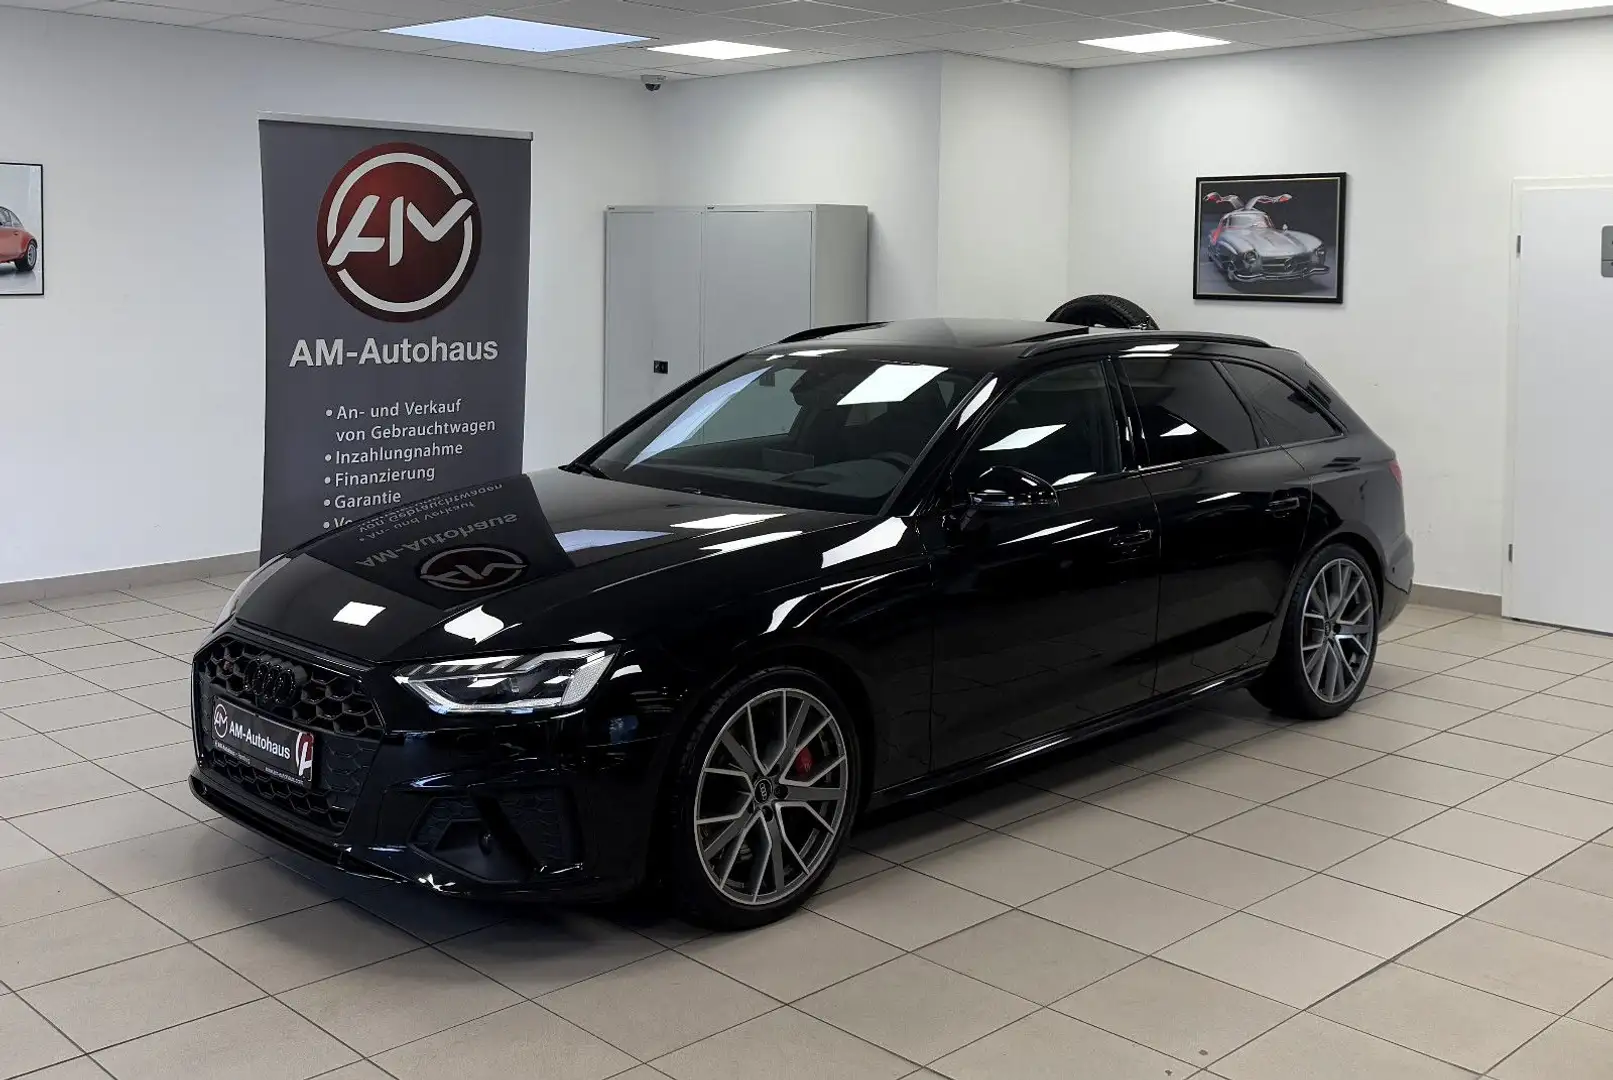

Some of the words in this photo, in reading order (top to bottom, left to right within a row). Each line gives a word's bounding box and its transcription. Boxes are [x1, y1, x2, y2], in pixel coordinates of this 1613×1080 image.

[289, 336, 499, 367] AM-Autohaus
[336, 405, 365, 420] An-
[370, 402, 399, 418] und
[404, 399, 462, 416] Verkauf
[336, 429, 366, 442] von
[371, 419, 496, 440] Gebrauchtwagen
[335, 443, 463, 464] Inzahlungnahme
[335, 466, 436, 487] Finanzierung
[334, 490, 401, 509] Garantie
[229, 720, 291, 760] AM-Autohaus
